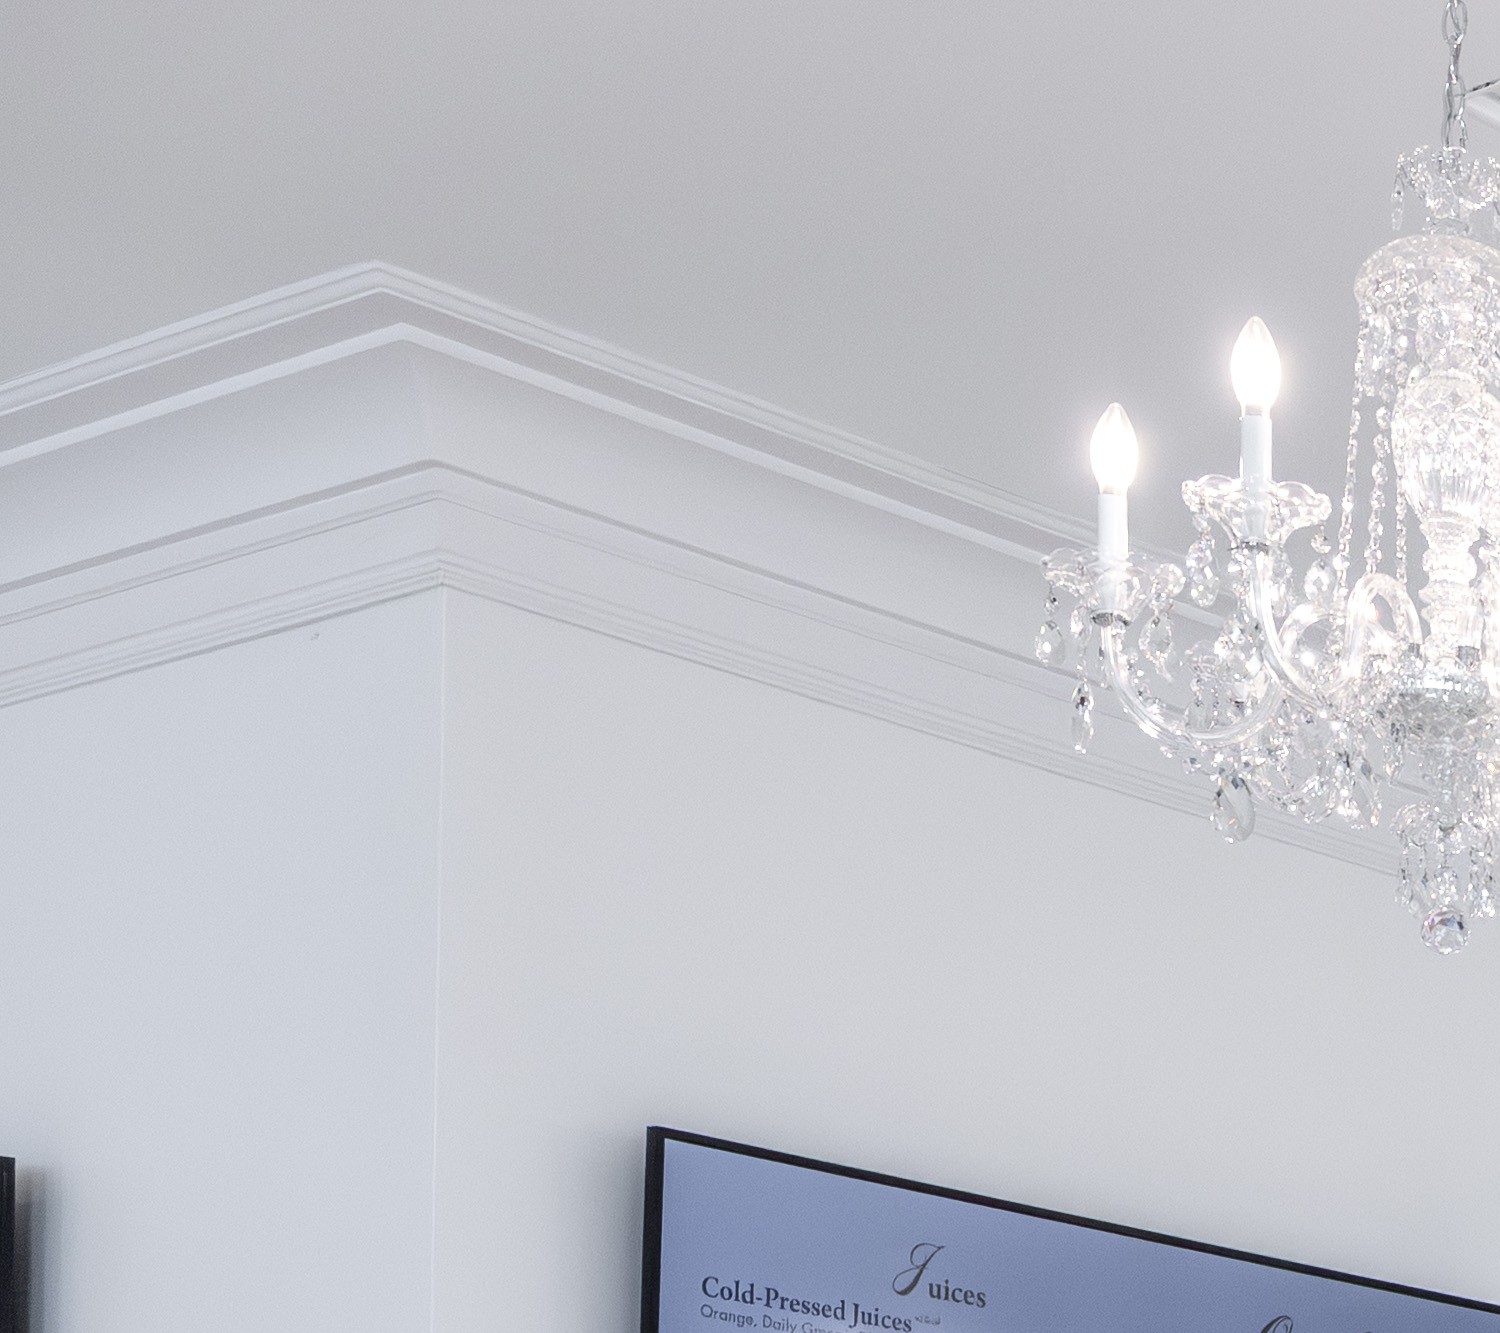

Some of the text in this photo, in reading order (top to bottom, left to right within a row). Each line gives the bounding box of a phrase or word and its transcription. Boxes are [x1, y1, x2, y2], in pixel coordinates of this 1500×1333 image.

[892, 1242, 986, 1308] Juices
[700, 1304, 757, 1328] Orange,
[701, 1276, 912, 1332] Cold-Pressed Juices
